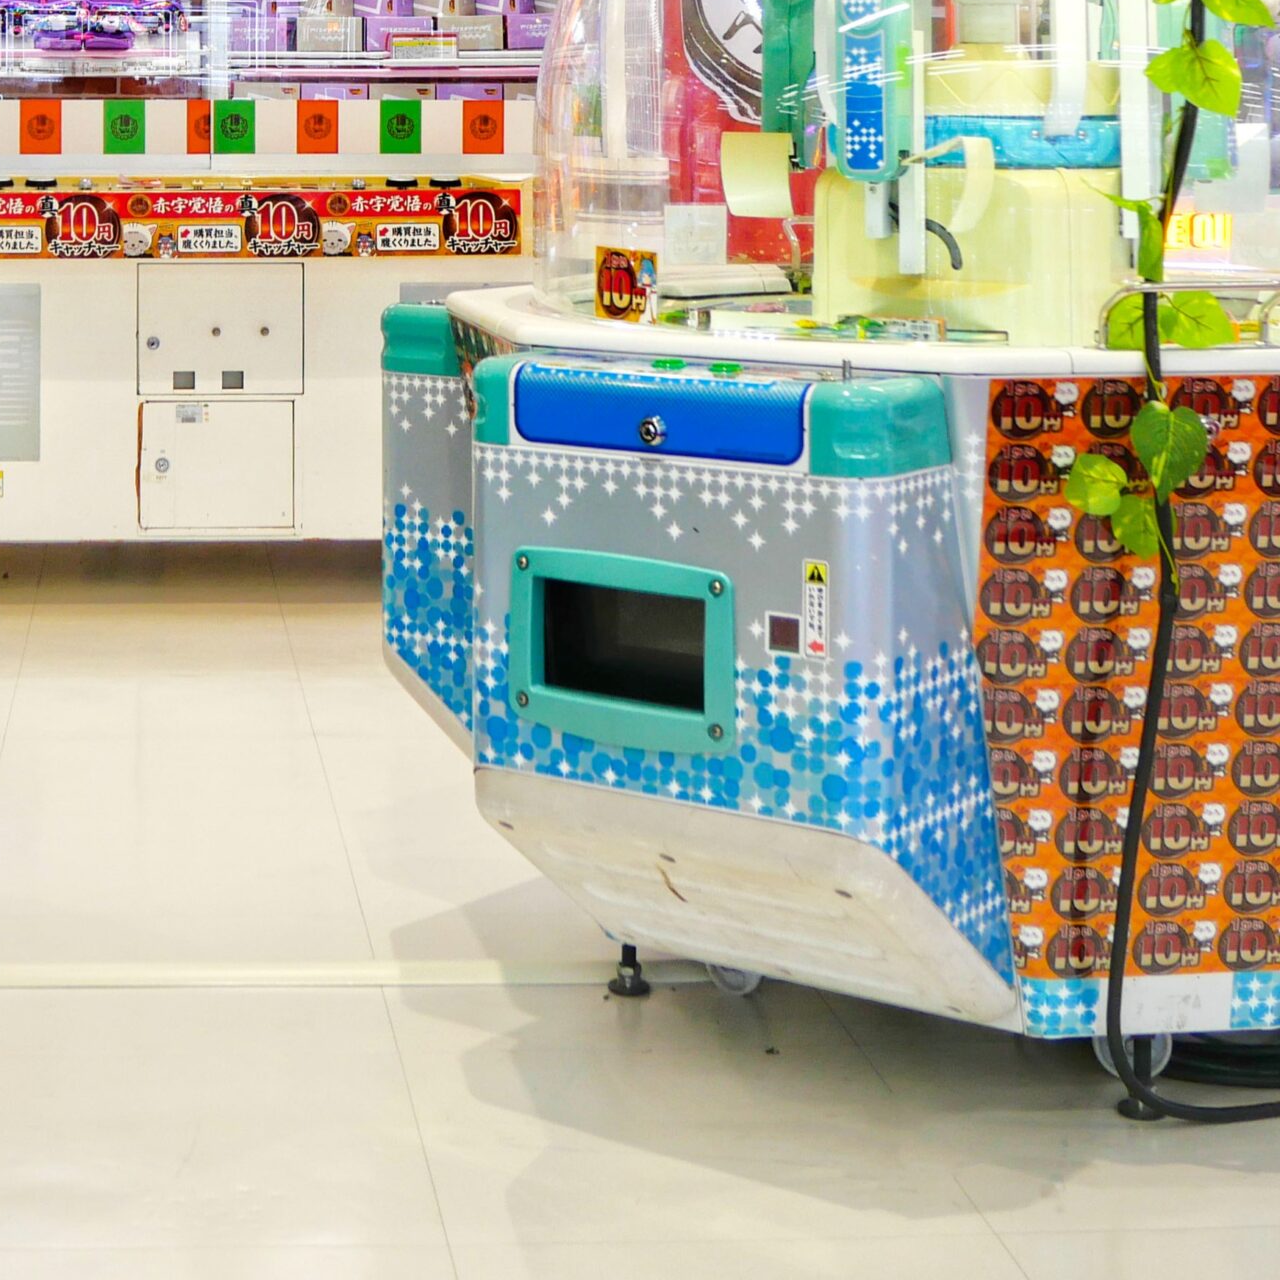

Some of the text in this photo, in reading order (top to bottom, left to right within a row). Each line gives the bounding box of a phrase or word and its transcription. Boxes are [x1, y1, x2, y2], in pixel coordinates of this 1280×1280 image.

[152, 197, 234, 215] 赤字覚悟の
[257, 200, 313, 241] 10円
[351, 195, 432, 213] 赤字覚悟の
[455, 199, 510, 240] 10円
[57, 202, 113, 243] 10円
[49, 240, 120, 258] キャッチャー
[247, 239, 320, 256] キャッチャー
[445, 237, 517, 255] キャッチャー
[602, 269, 646, 312] 10円
[1000, 396, 1062, 432] 10円
[997, 459, 1058, 494] 10円
[993, 521, 1054, 556] 10円
[989, 582, 1050, 618] 10円
[1079, 581, 1138, 615] 10円
[986, 643, 1045, 677] 10円
[1074, 641, 1133, 675] 10円
[981, 702, 1042, 738] 10円
[1071, 700, 1130, 734] 10円
[1068, 761, 1127, 795] 10円
[1154, 757, 1213, 791] 10円
[1064, 820, 1123, 854] 10円
[1150, 817, 1209, 851] 10円
[1059, 879, 1118, 913] 10円
[1146, 876, 1205, 910] 10円
[1141, 933, 1200, 967] 10円
